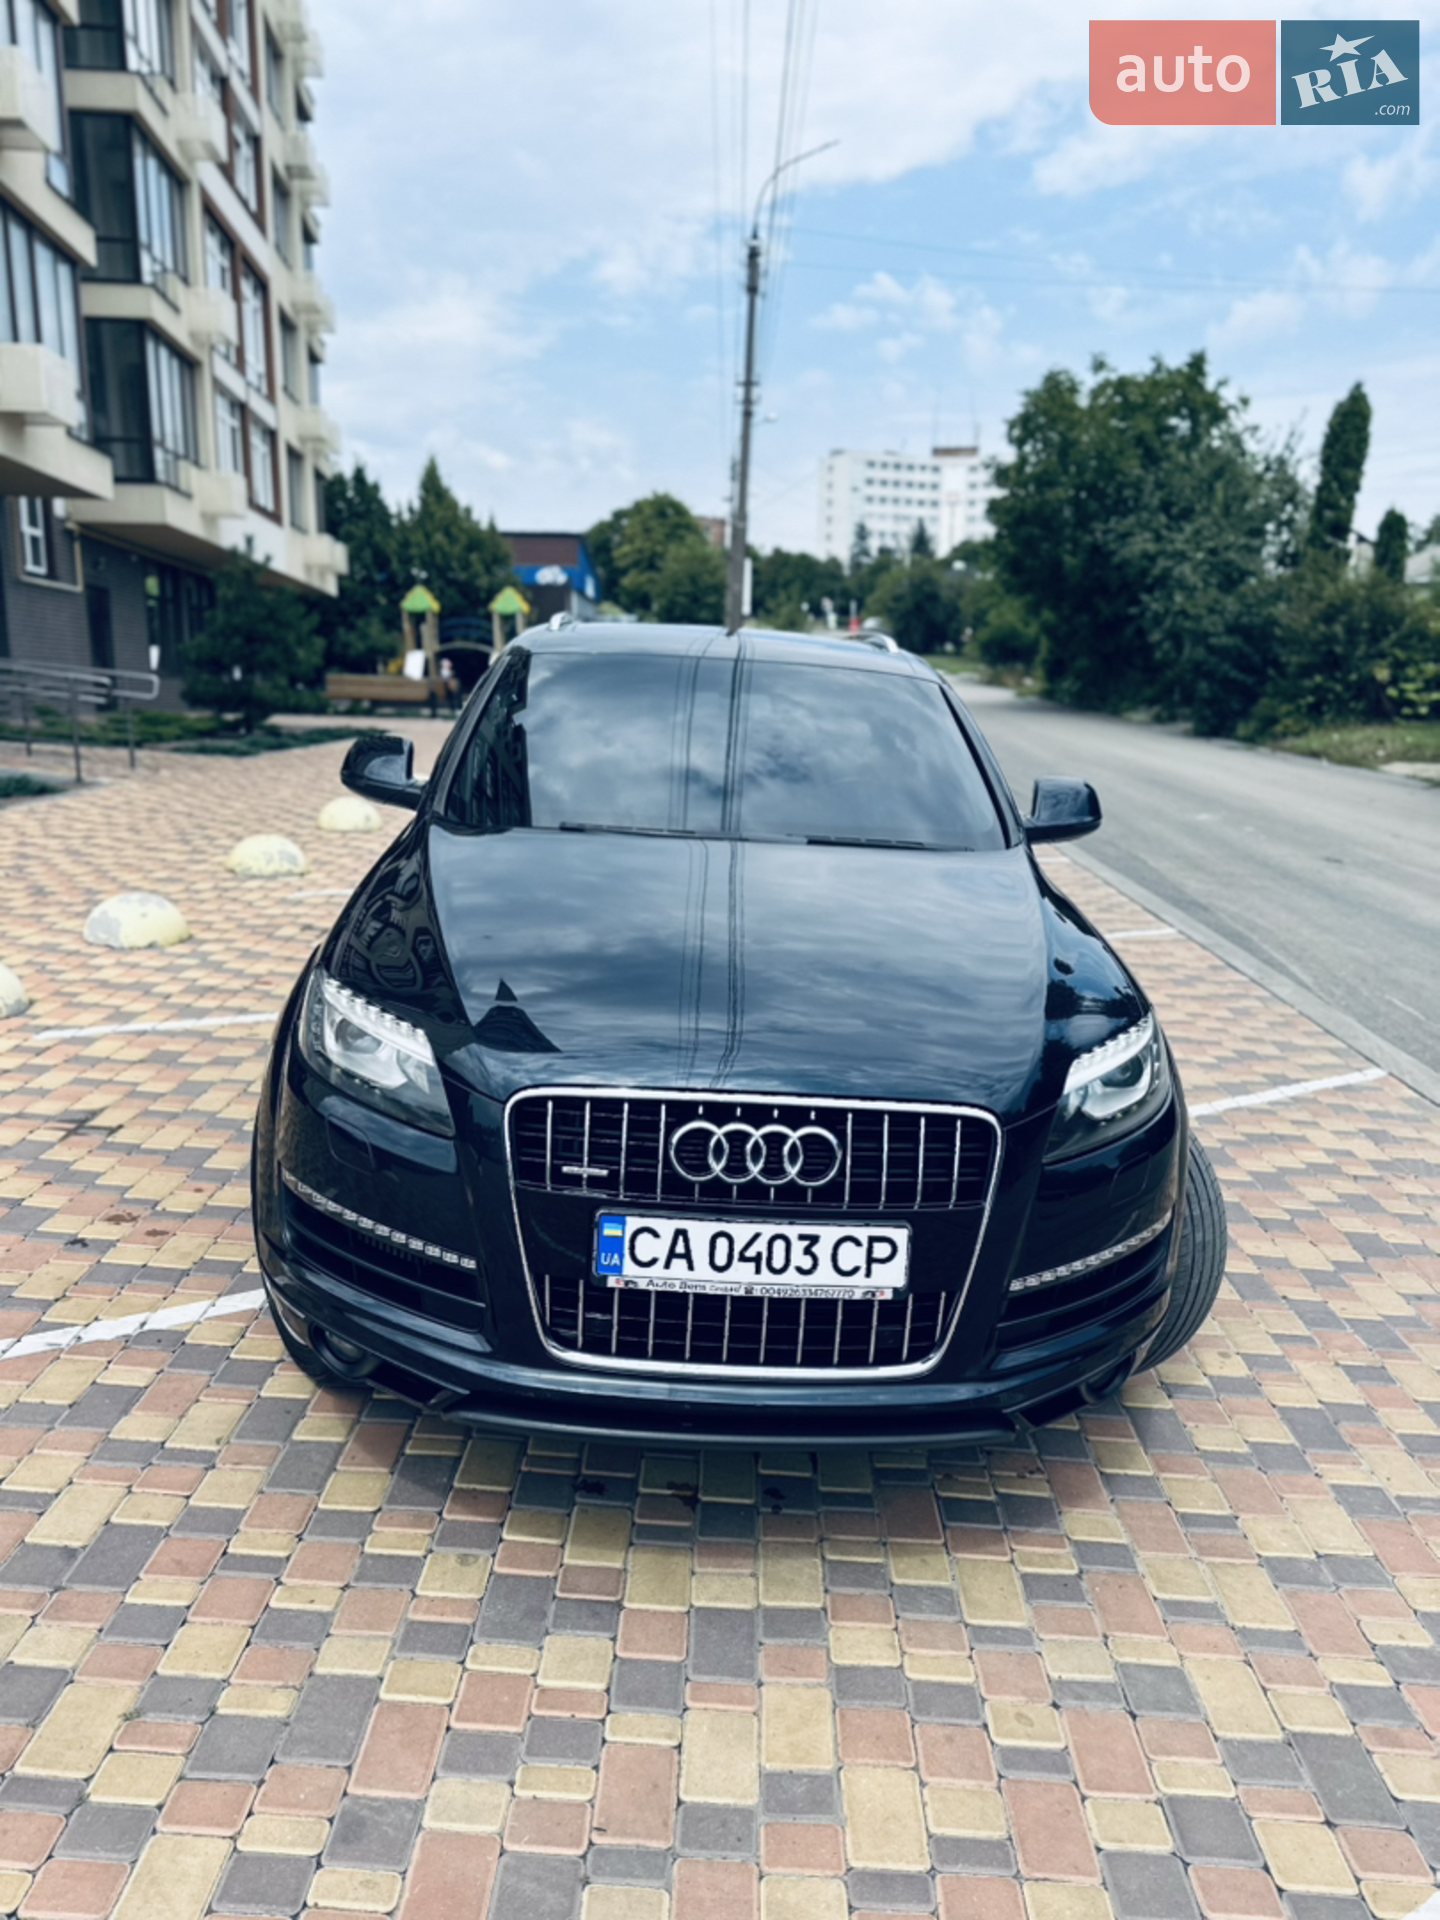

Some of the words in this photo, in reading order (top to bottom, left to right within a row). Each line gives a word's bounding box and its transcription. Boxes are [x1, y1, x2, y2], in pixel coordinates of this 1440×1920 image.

[600, 1252, 621, 1266] UA
[627, 1226, 695, 1272] CA
[708, 1230, 821, 1275] 0403
[830, 1235, 899, 1278] CP
[645, 1279, 676, 1289] Auto
